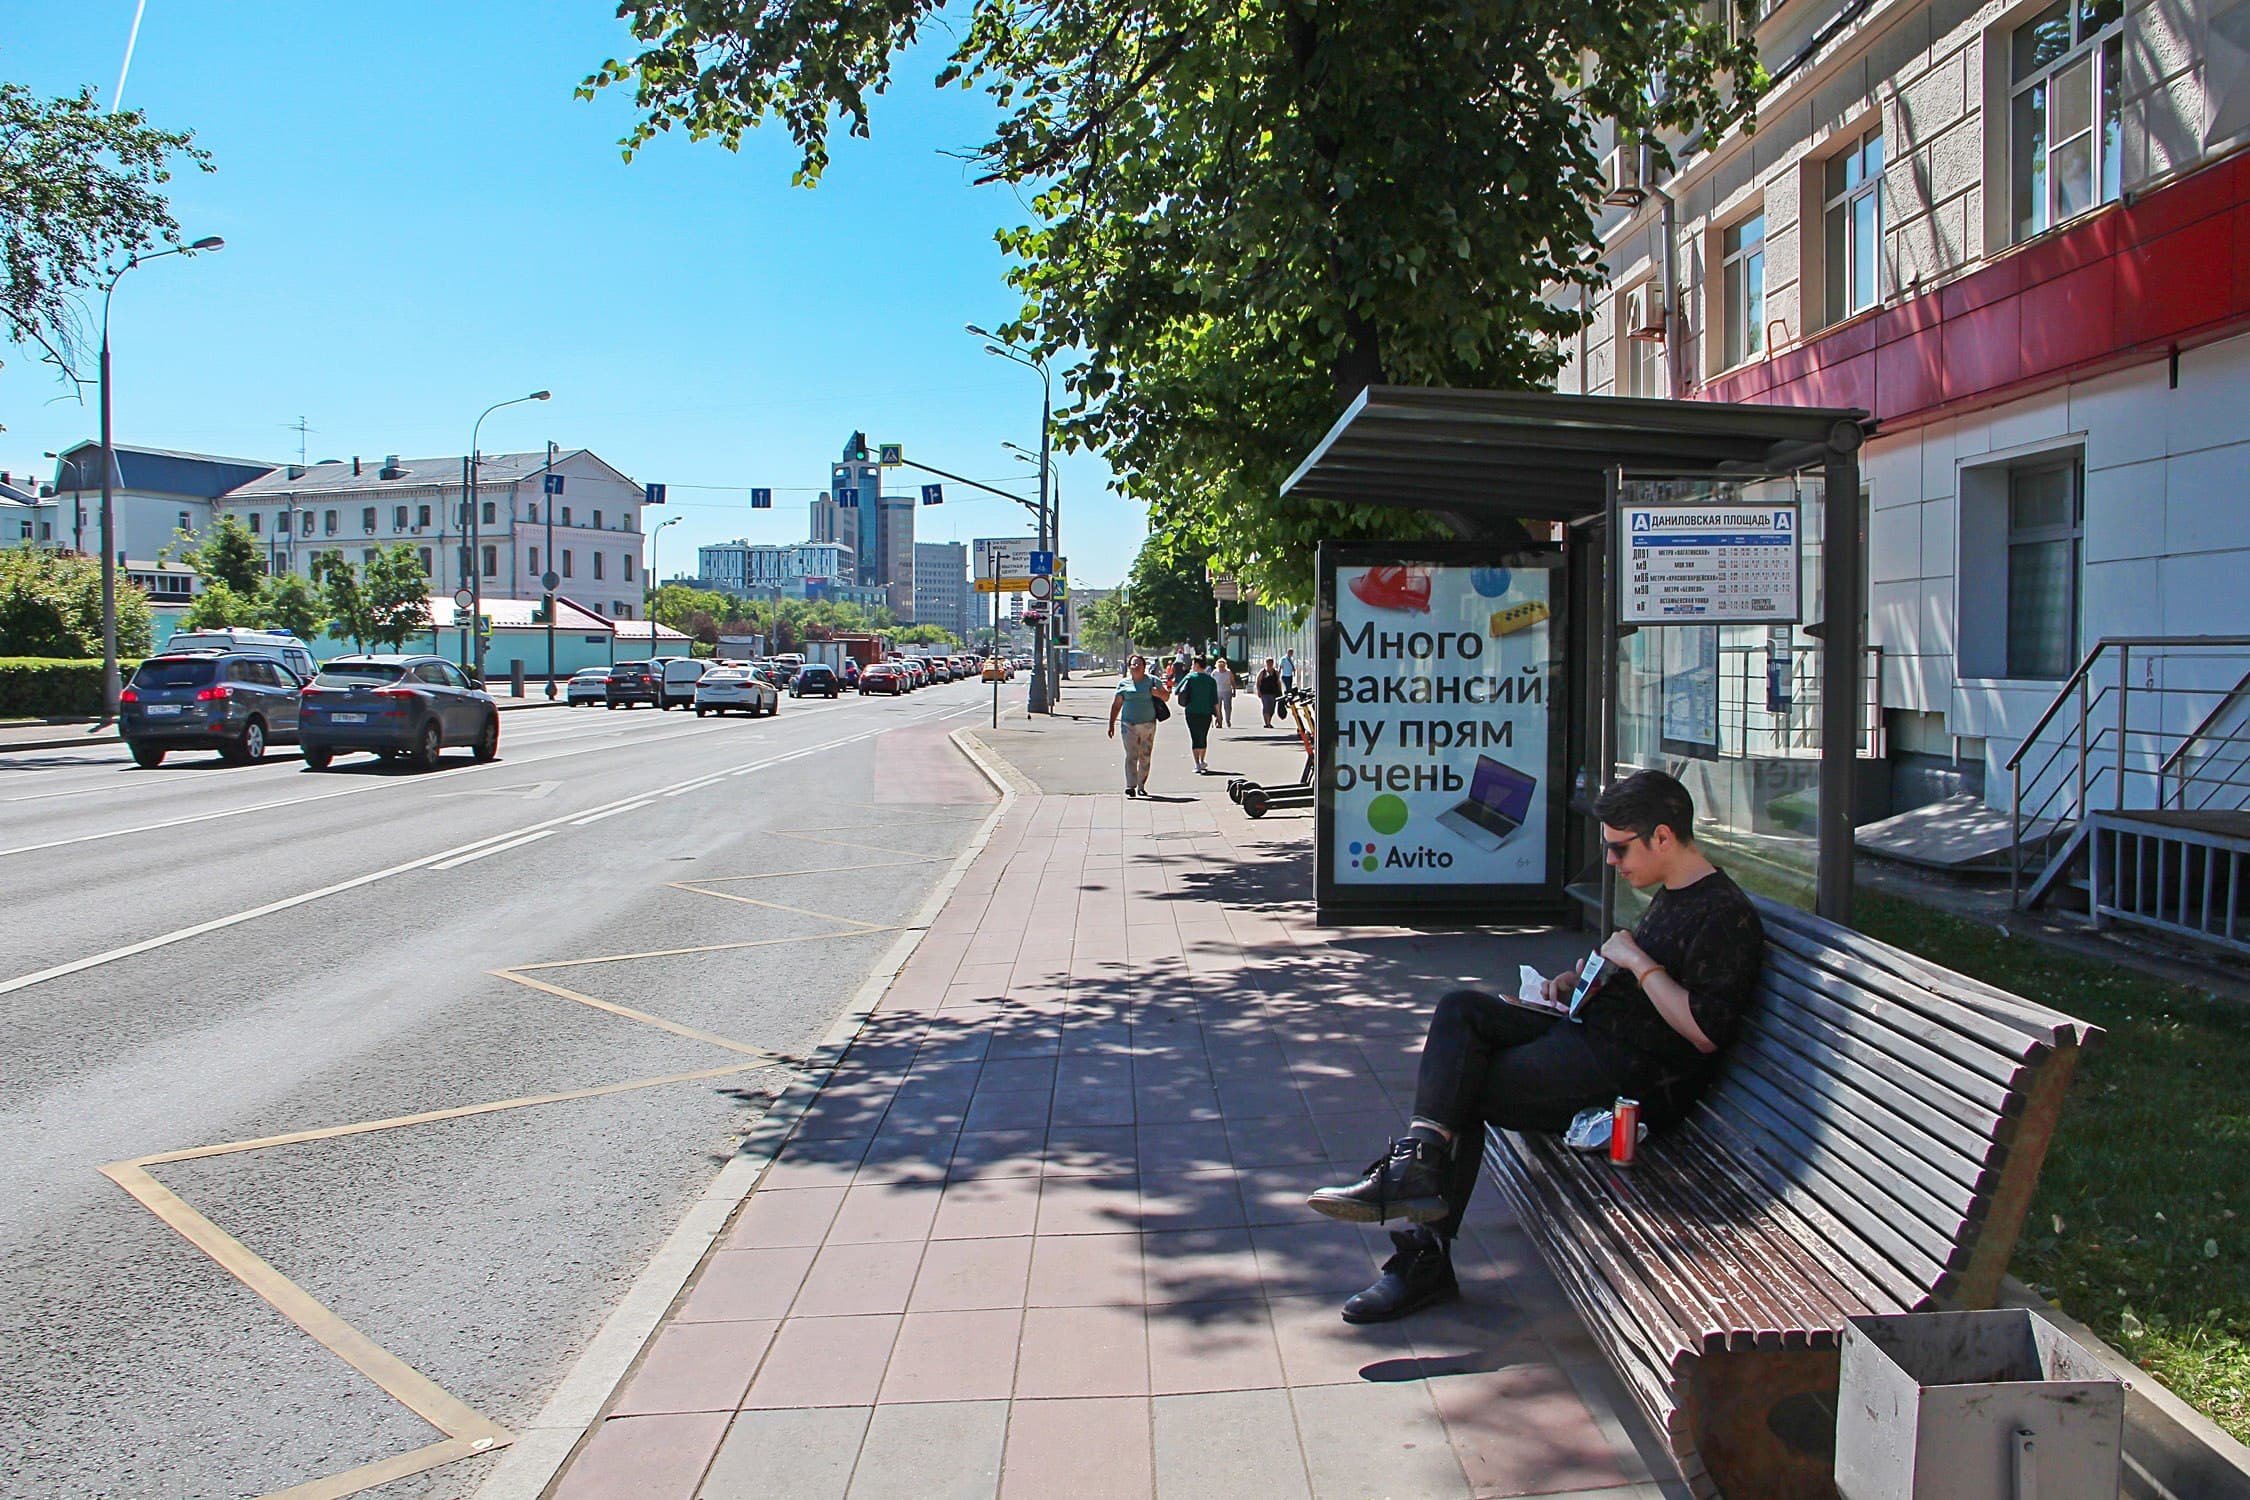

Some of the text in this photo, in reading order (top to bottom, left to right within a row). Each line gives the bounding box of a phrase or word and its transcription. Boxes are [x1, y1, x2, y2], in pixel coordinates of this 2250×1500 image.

[1651, 515, 1721, 528] ДАНИЛОВСКАЯ
[1723, 514, 1770, 527] ПЛОЩАДЬ
[1336, 621, 1483, 660] Много
[1336, 665, 1542, 704] вакансий
[1336, 719, 1513, 756] ну прям
[1335, 763, 1464, 792] очень
[1385, 845, 1454, 869] Avito
